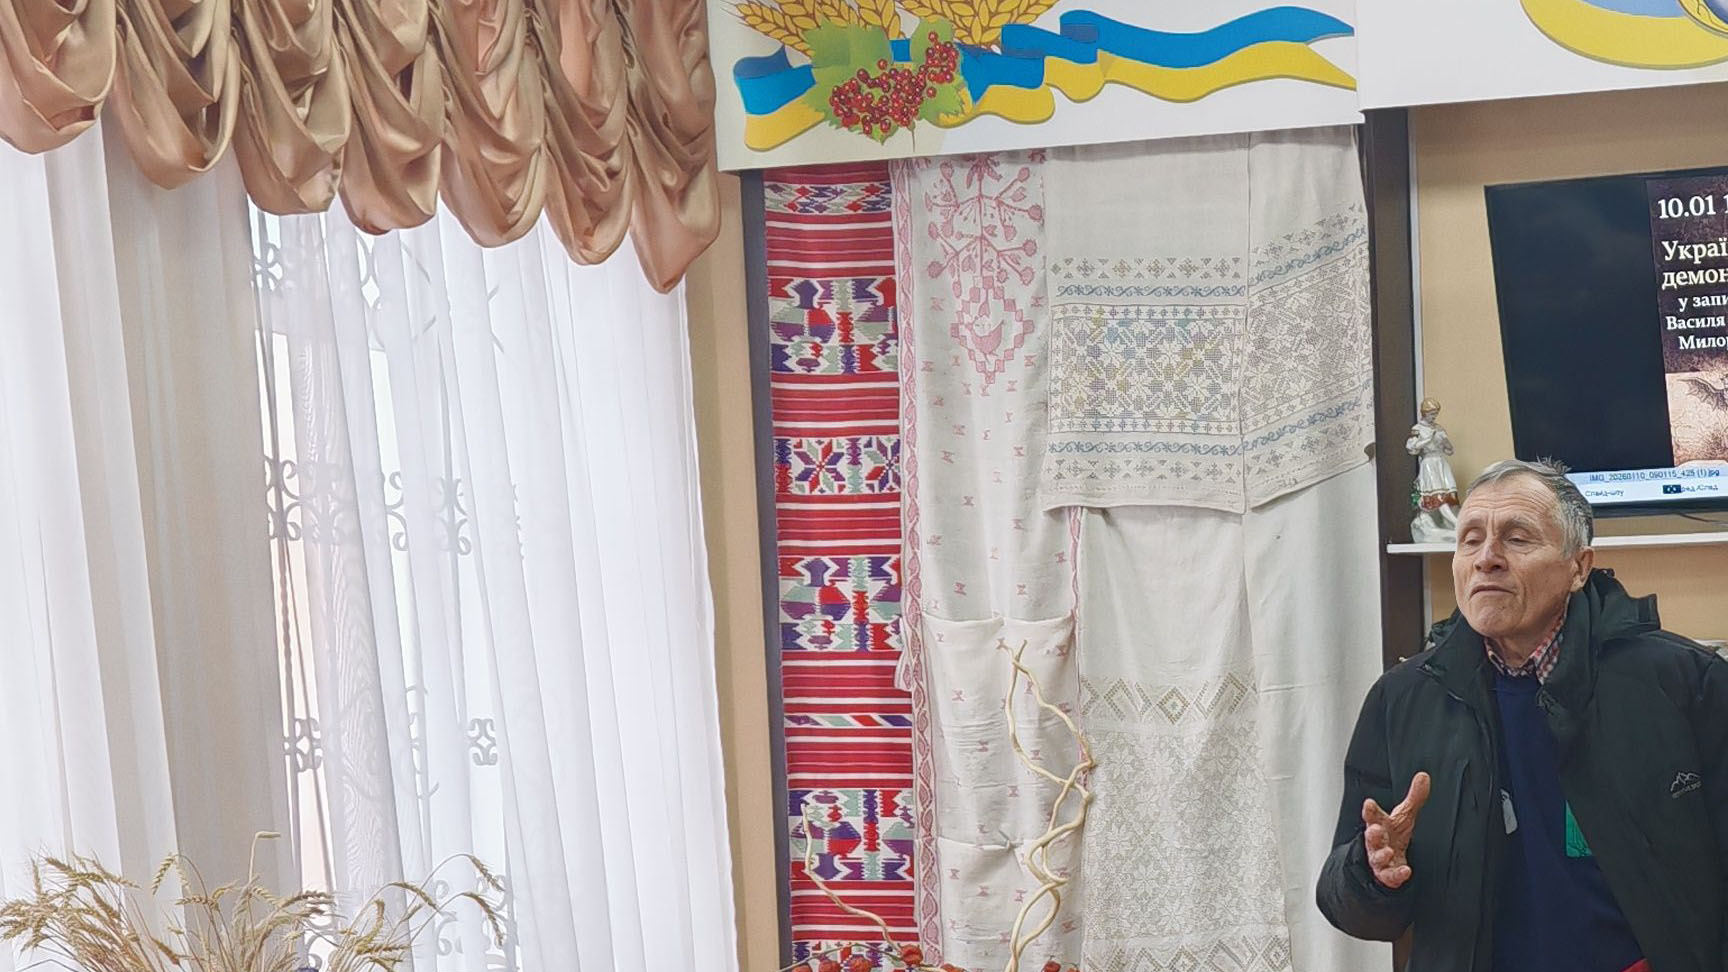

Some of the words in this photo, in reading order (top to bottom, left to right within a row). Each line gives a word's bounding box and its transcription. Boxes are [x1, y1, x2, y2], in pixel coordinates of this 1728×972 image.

[1657, 194, 1716, 219] 10.01
[1678, 297, 1688, 312] у
[1665, 315, 1726, 330] Василя
